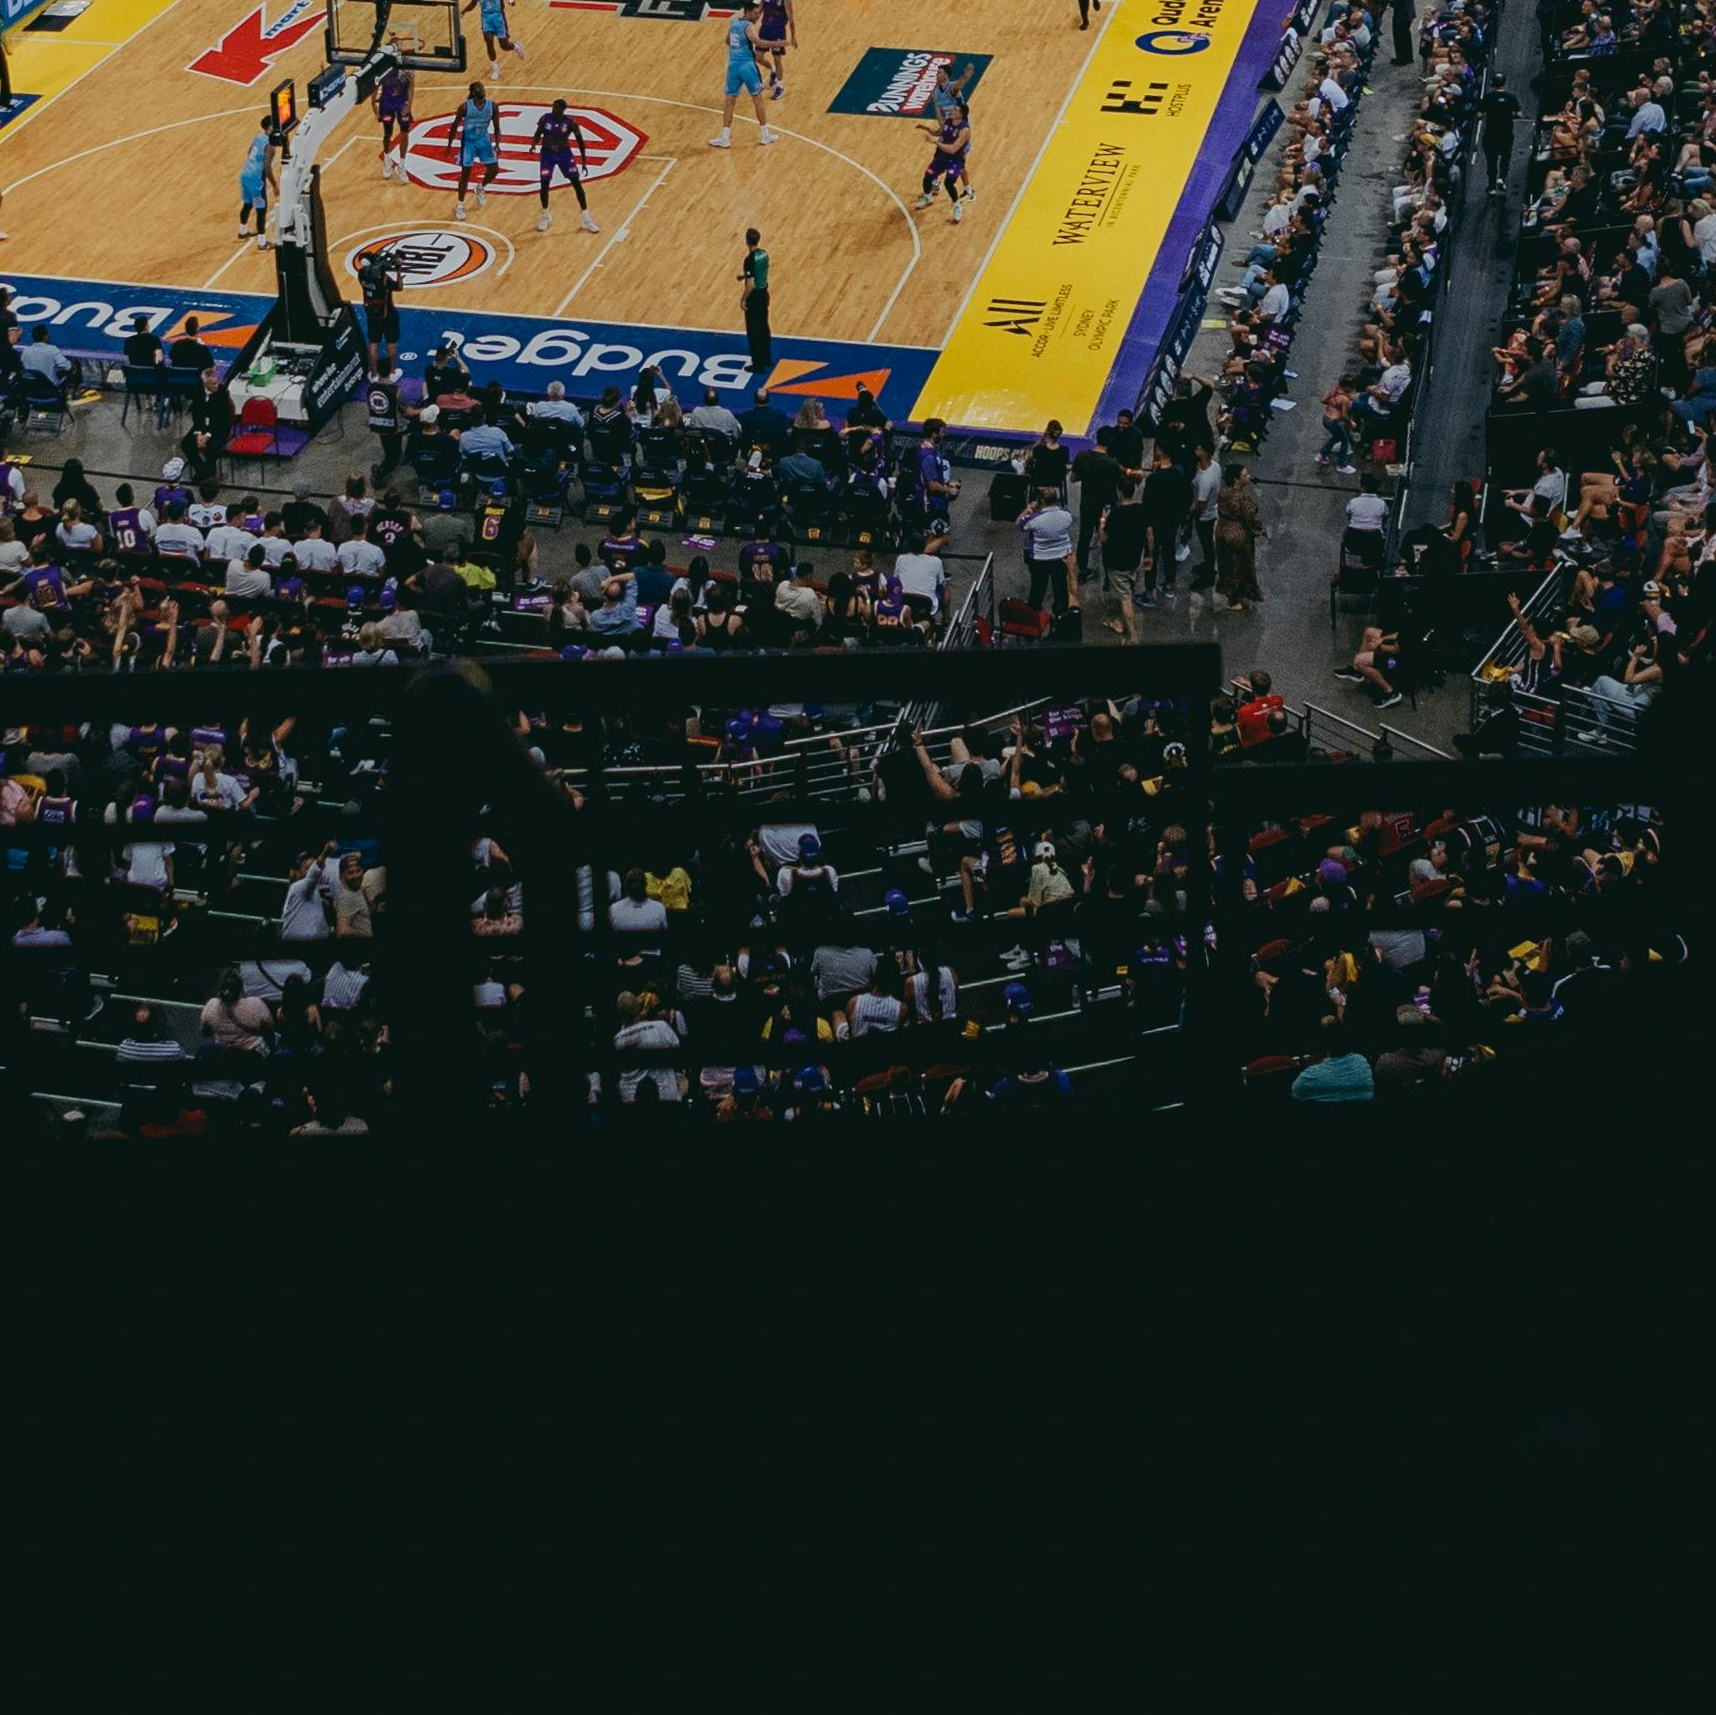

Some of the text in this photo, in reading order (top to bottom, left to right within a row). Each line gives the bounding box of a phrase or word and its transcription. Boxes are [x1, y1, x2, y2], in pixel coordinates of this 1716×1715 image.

[867, 52, 932, 114] BUNNINGS
[1166, 84, 1191, 117] HOSTPLUS
[1052, 142, 1127, 247] WATERVIEW
[1031, 284, 1073, 359] ACCOR LIVE LIMITLESS
[1073, 309, 1097, 338] SYDNEY
[1088, 298, 1121, 352] OLYMPIC PARK
[437, 329, 754, 391] Budget
[974, 444, 1010, 462] HOOPS
